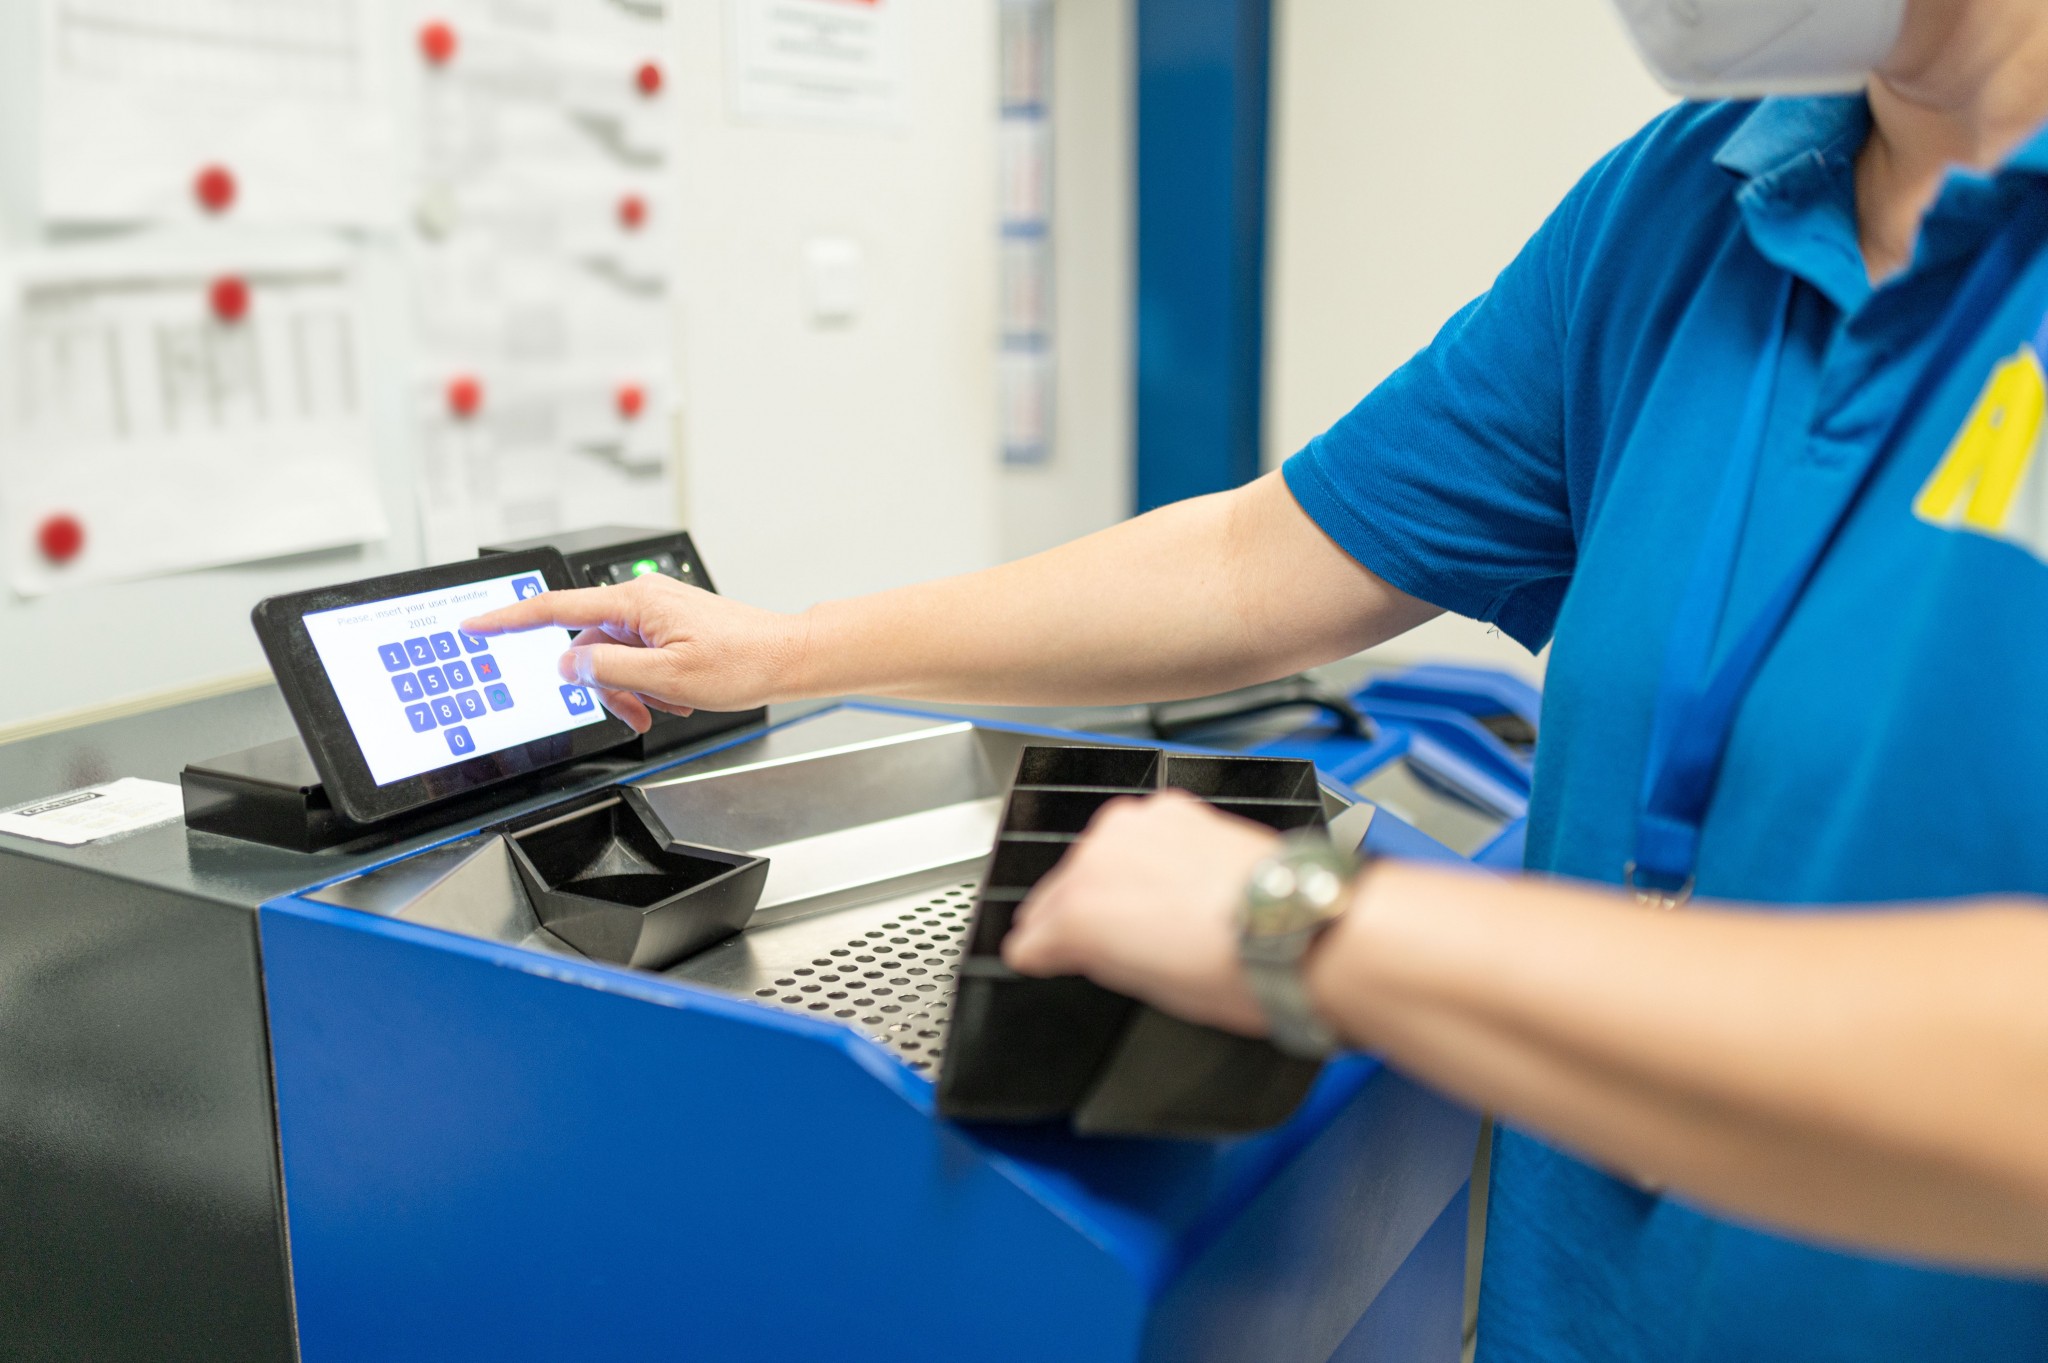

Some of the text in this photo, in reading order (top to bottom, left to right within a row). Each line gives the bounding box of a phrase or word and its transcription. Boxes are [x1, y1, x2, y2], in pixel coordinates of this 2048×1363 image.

[337, 590, 489, 627] Please, insert your user identifier
[408, 615, 438, 629] 20102
[388, 639, 451, 665] 1 2 3
[402, 669, 464, 695] 4 5 6
[415, 698, 477, 726] 7 8 9
[454, 734, 466, 748] 0
